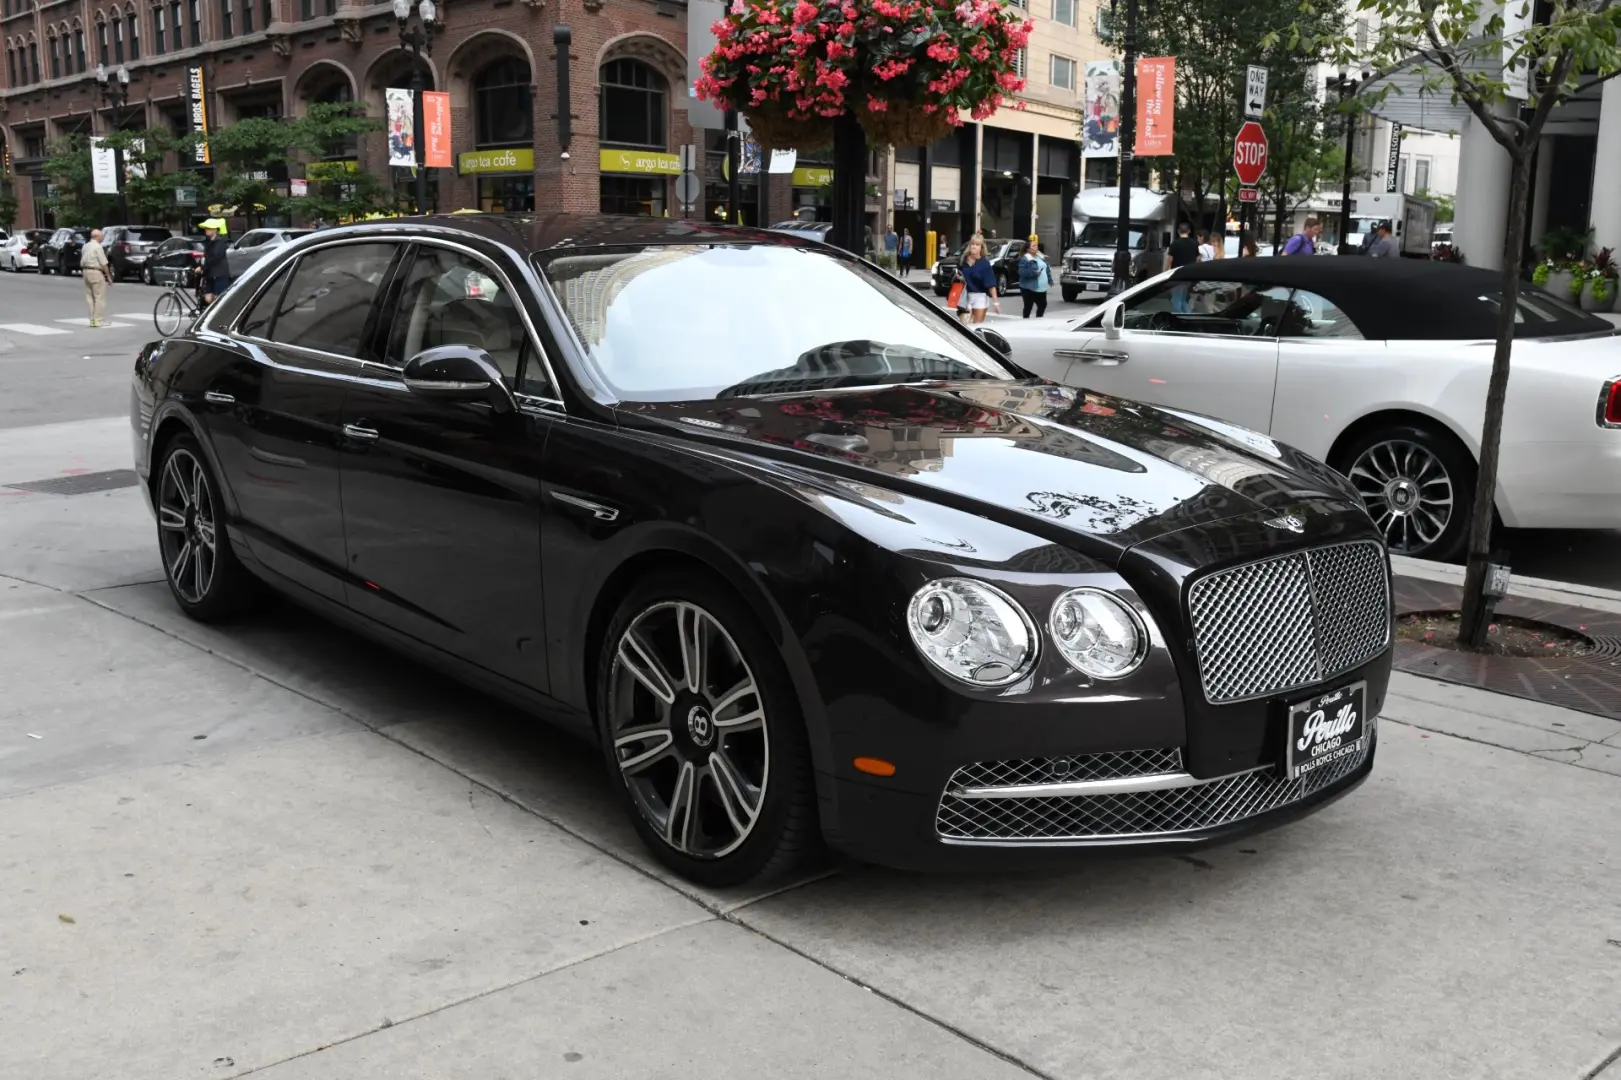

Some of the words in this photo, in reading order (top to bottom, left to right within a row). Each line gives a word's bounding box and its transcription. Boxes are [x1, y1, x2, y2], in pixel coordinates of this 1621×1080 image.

[190, 67, 202, 100] BAGELS
[1249, 70, 1265, 84] ONE
[1153, 64, 1164, 115] Following
[1248, 85, 1264, 97] WAY
[1145, 99, 1154, 115] the
[1145, 119, 1154, 137] Box
[195, 125, 206, 162] EINSN
[1236, 142, 1266, 166] STOP
[493, 150, 517, 167] café
[635, 158, 656, 172] argo
[658, 158, 668, 169] tea
[1387, 170, 1396, 191] rack
[1297, 703, 1357, 751] Perillo
[1311, 736, 1342, 757] CHICAGO
[1300, 760, 1316, 774] ROLLS
[1316, 752, 1333, 767] ROYCE
[1333, 744, 1355, 759] CHICAGO
